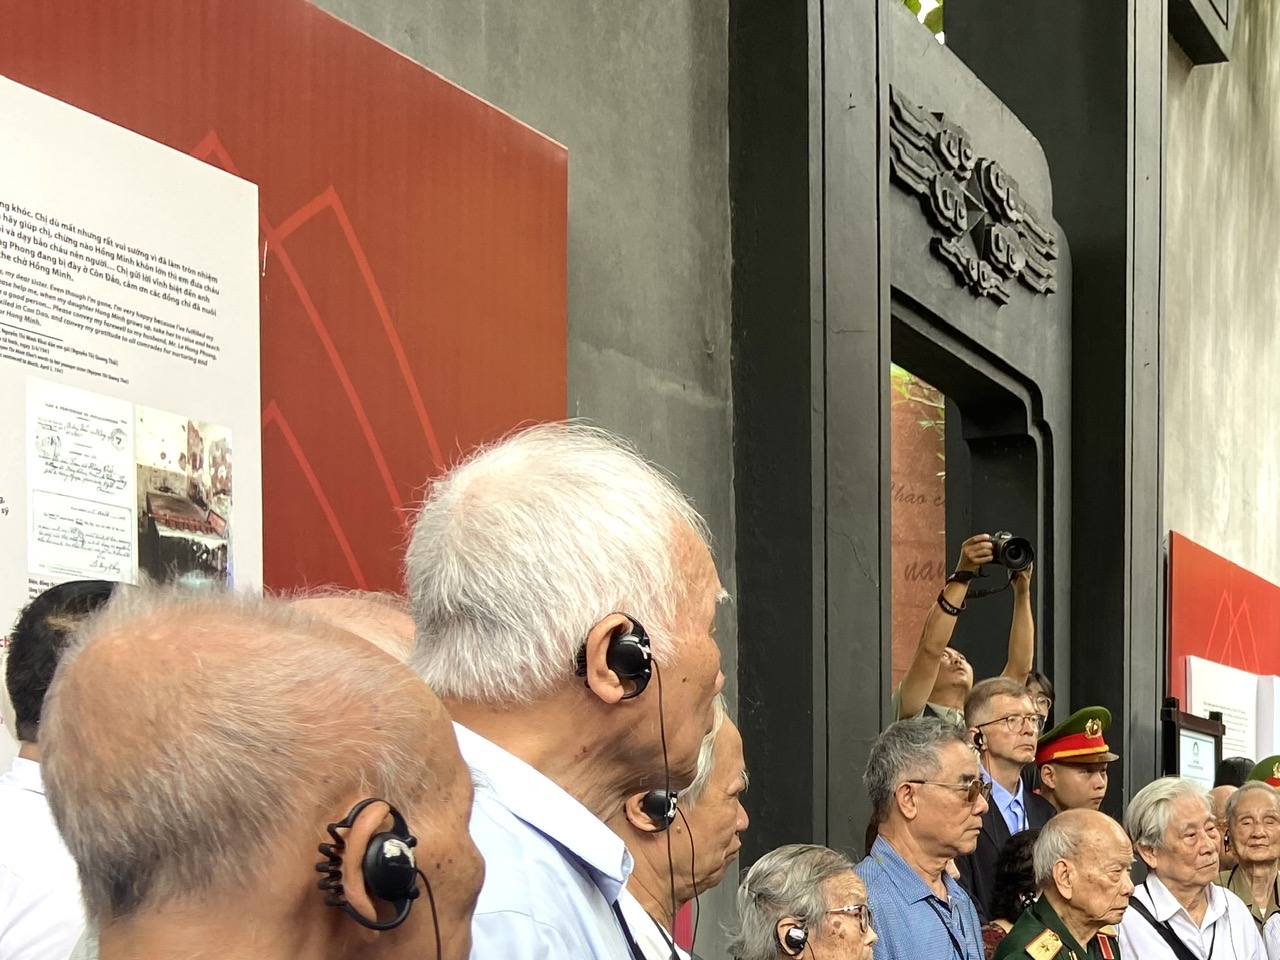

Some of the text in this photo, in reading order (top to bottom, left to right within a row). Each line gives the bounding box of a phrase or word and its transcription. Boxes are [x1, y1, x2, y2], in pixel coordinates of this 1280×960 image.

[3, 213, 219, 295] hãy giúp chị, chừng nào Hồng Minh khôn lớn thì em đưa cháu
[12, 204, 32, 218] khóc.
[35, 212, 47, 225] Chị
[49, 218, 59, 227] dù
[61, 223, 76, 233] mất
[78, 229, 102, 244] nhưng
[103, 237, 113, 247] rất
[115, 242, 126, 251] vui
[128, 247, 149, 260] sướng
[158, 256, 167, 265] đã
[168, 259, 180, 270] làm
[182, 265, 196, 275] tròn
[197, 271, 218, 283] nhiệm
[10, 241, 35, 258] Phong
[37, 251, 56, 265] đang
[58, 257, 66, 268] bị
[67, 261, 81, 273] đày
[83, 265, 88, 273] ở
[89, 268, 104, 279] Côn
[105, 273, 121, 286] Đảo,
[123, 280, 138, 290] cảm
[150, 289, 161, 298] các
[162, 293, 180, 306] đồng
[181, 299, 191, 308] chí
[192, 303, 200, 311] đã
[202, 307, 216, 316] nuôi
[13, 256, 28, 266] chở
[29, 260, 50, 275] Hồng
[52, 268, 74, 281] Minh.
[17, 231, 31, 244] dạy
[33, 236, 48, 248] bảo
[50, 243, 68, 255] cháu
[70, 251, 84, 260] nên
[86, 256, 114, 270] người...
[116, 265, 128, 277] Chị
[129, 271, 141, 279] gửi
[142, 273, 151, 283] lời
[152, 278, 168, 289] vĩnh
[169, 283, 182, 294] biệt
[184, 288, 196, 298] đến
[198, 294, 210, 303] anh
[13, 282, 27, 292] help
[40, 292, 56, 300] when
[67, 300, 94, 312] daughter
[16, 273, 30, 282] dear
[31, 279, 48, 288] sister.
[50, 284, 64, 293] Even
[65, 290, 86, 300] though
[8, 292, 25, 301] good
[25, 298, 51, 309] person...
[53, 304, 72, 315] Please
[73, 312, 93, 323] convey
[36, 309, 49, 319] Dao,
[64, 319, 84, 330] convey
